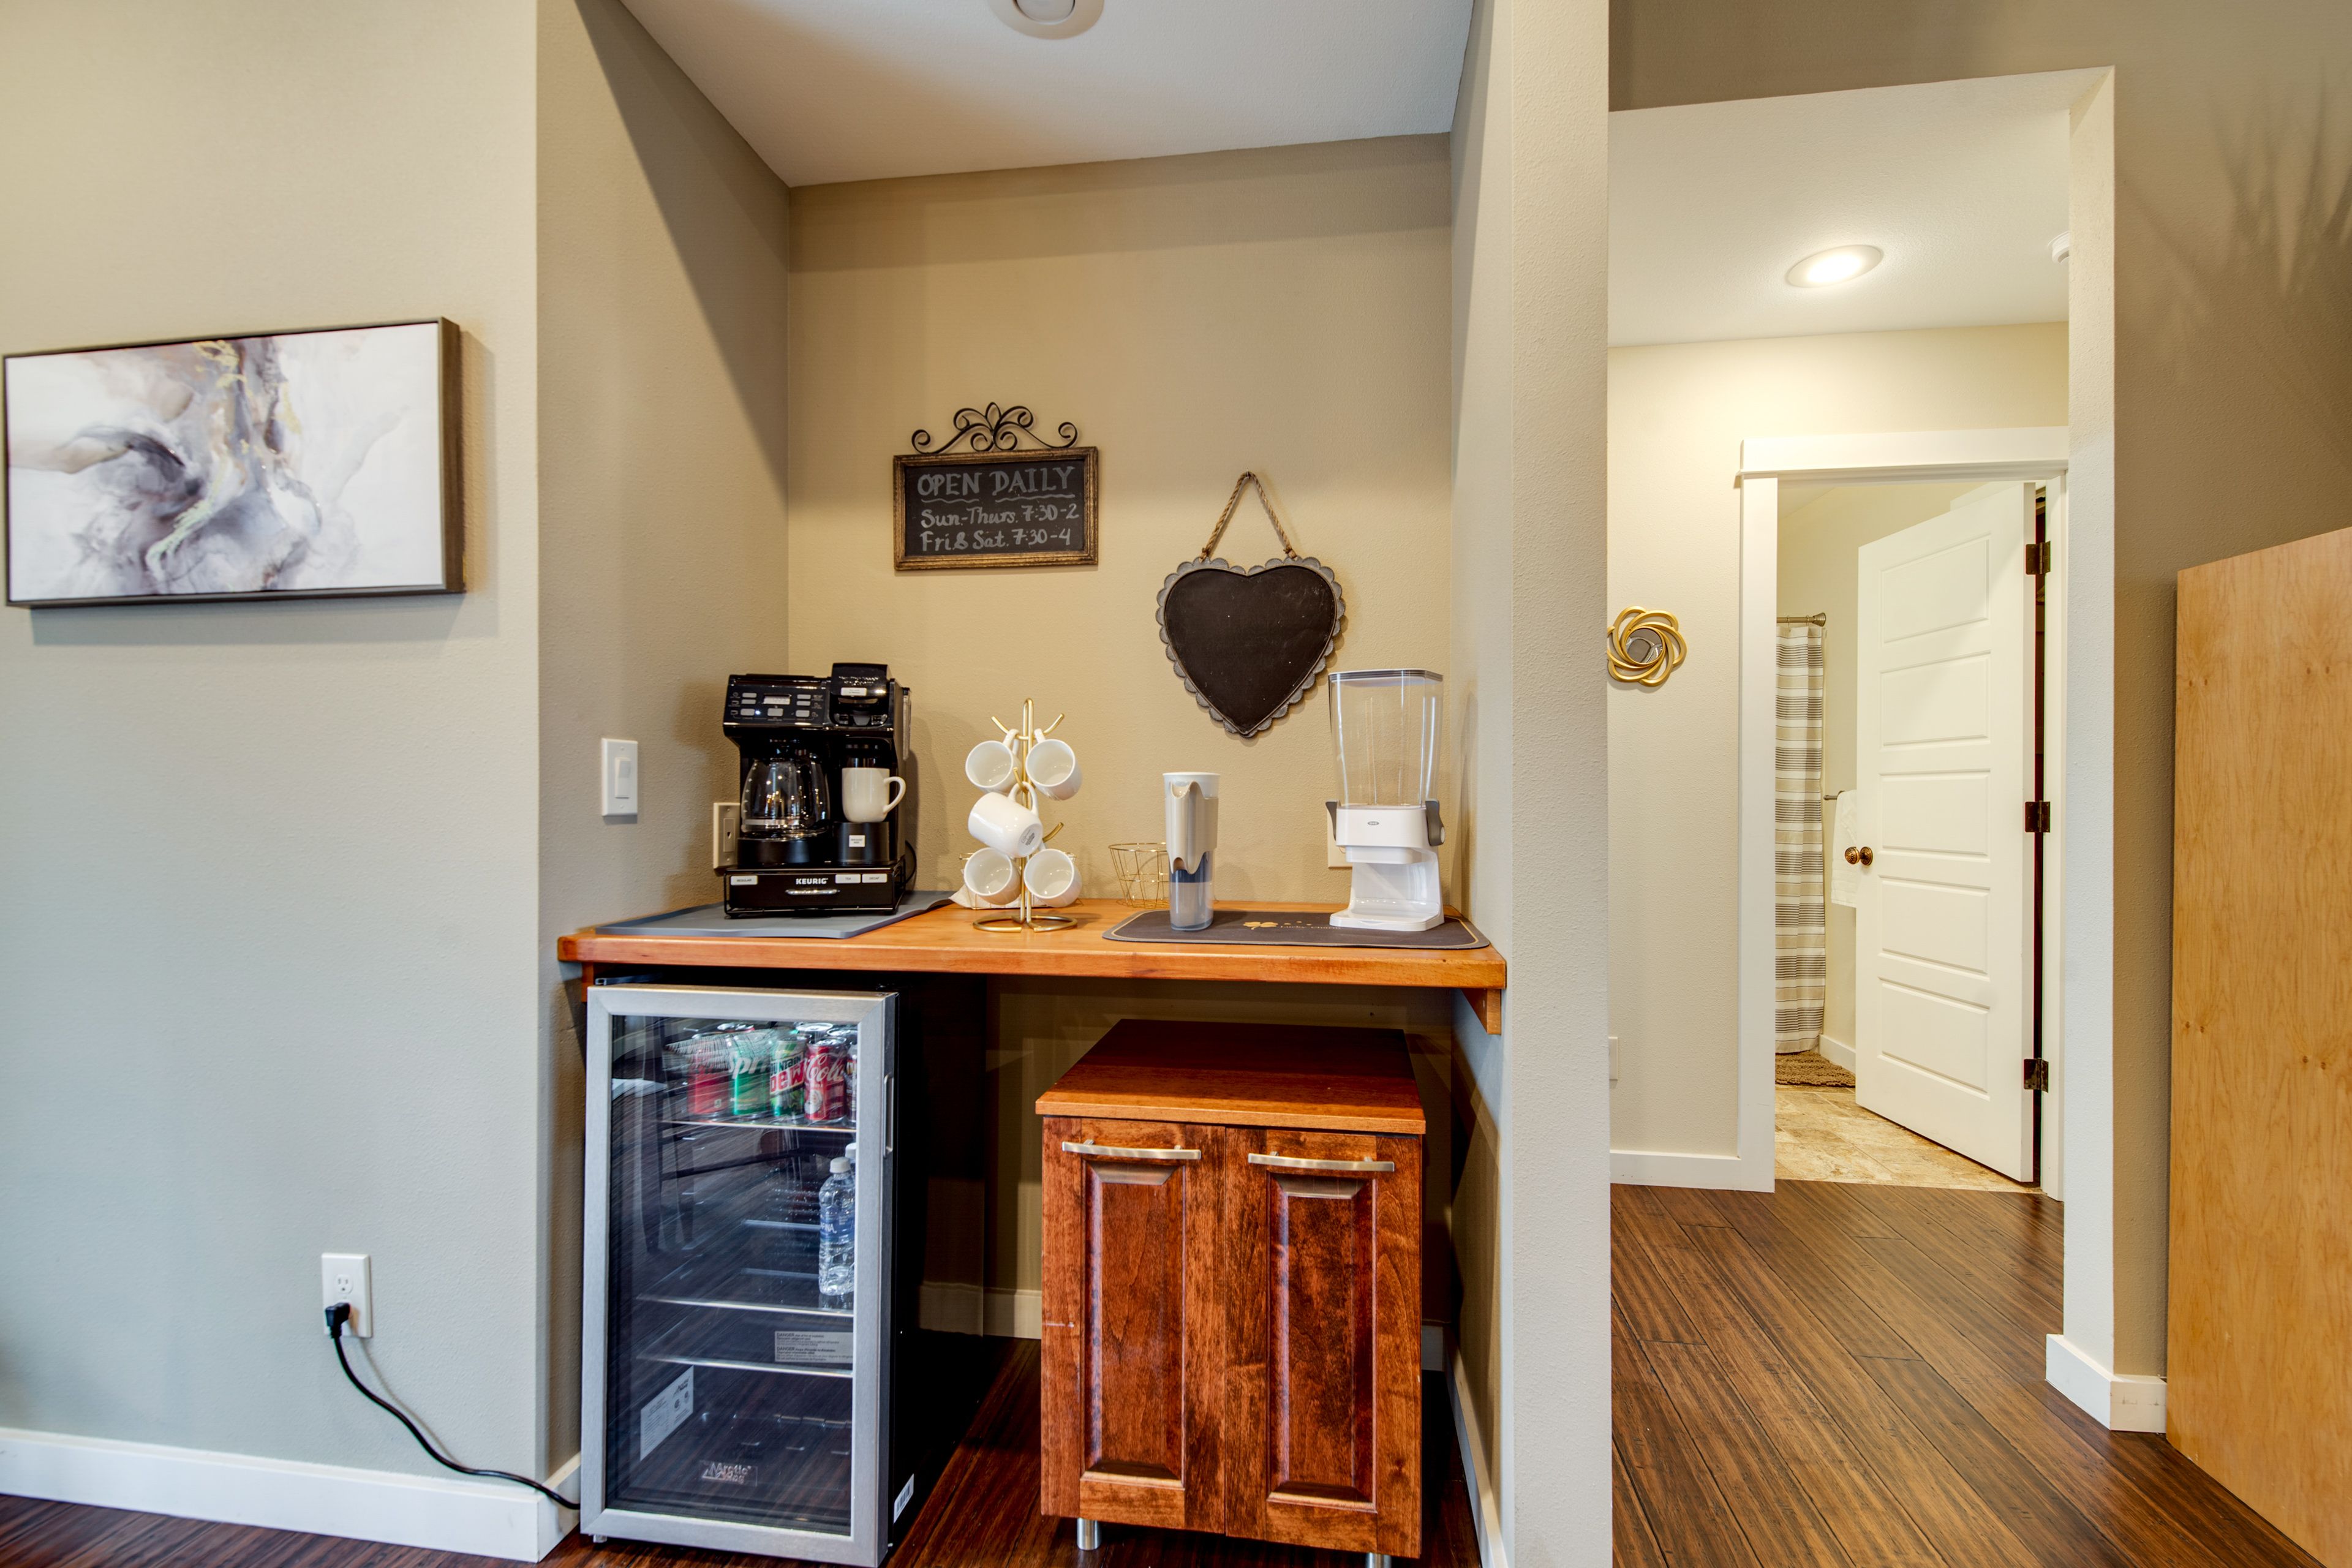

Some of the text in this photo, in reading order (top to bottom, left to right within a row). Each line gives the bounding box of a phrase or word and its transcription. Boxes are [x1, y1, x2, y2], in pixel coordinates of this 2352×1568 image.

[918, 466, 1076, 496] OPEN DAILY
[972, 530, 1009, 549] Sat.
